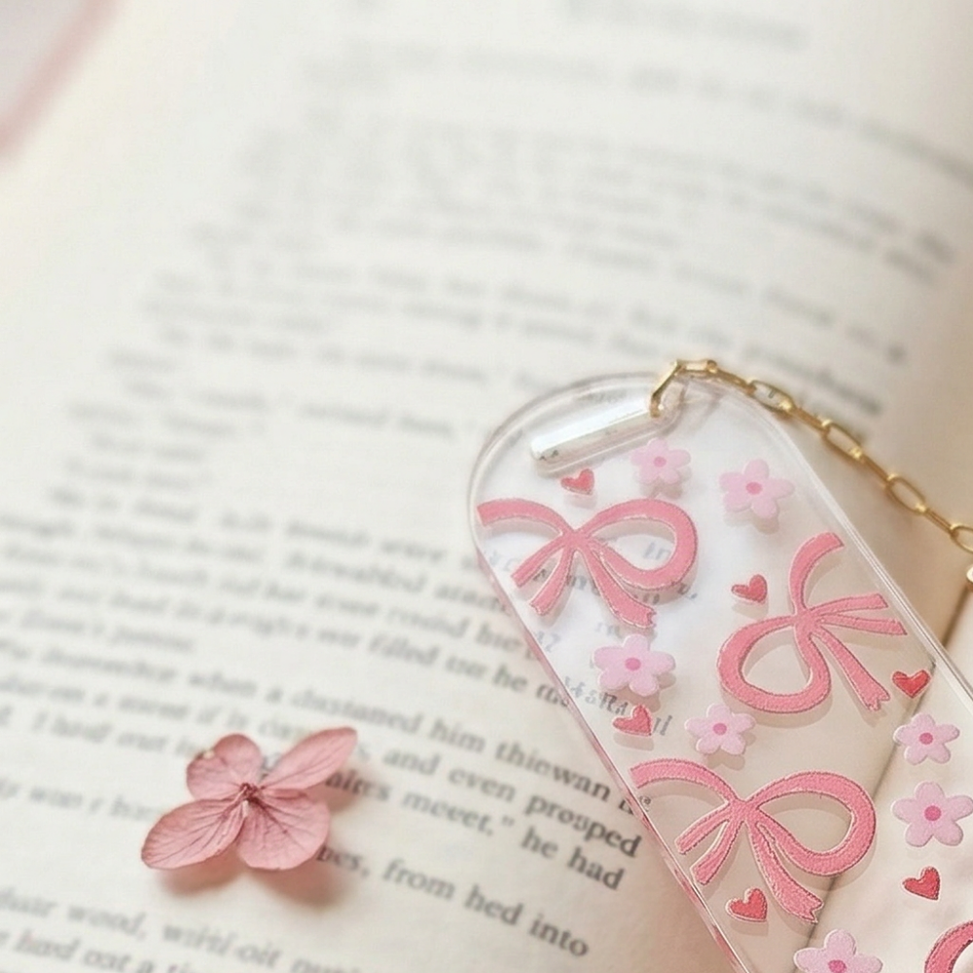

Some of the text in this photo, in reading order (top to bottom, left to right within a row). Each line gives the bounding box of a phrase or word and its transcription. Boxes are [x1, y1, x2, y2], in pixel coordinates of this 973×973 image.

[520, 824, 560, 860] he
[565, 845, 627, 892] had
[382, 855, 457, 902] from
[464, 882, 525, 928] hed
[527, 911, 591, 959] into
